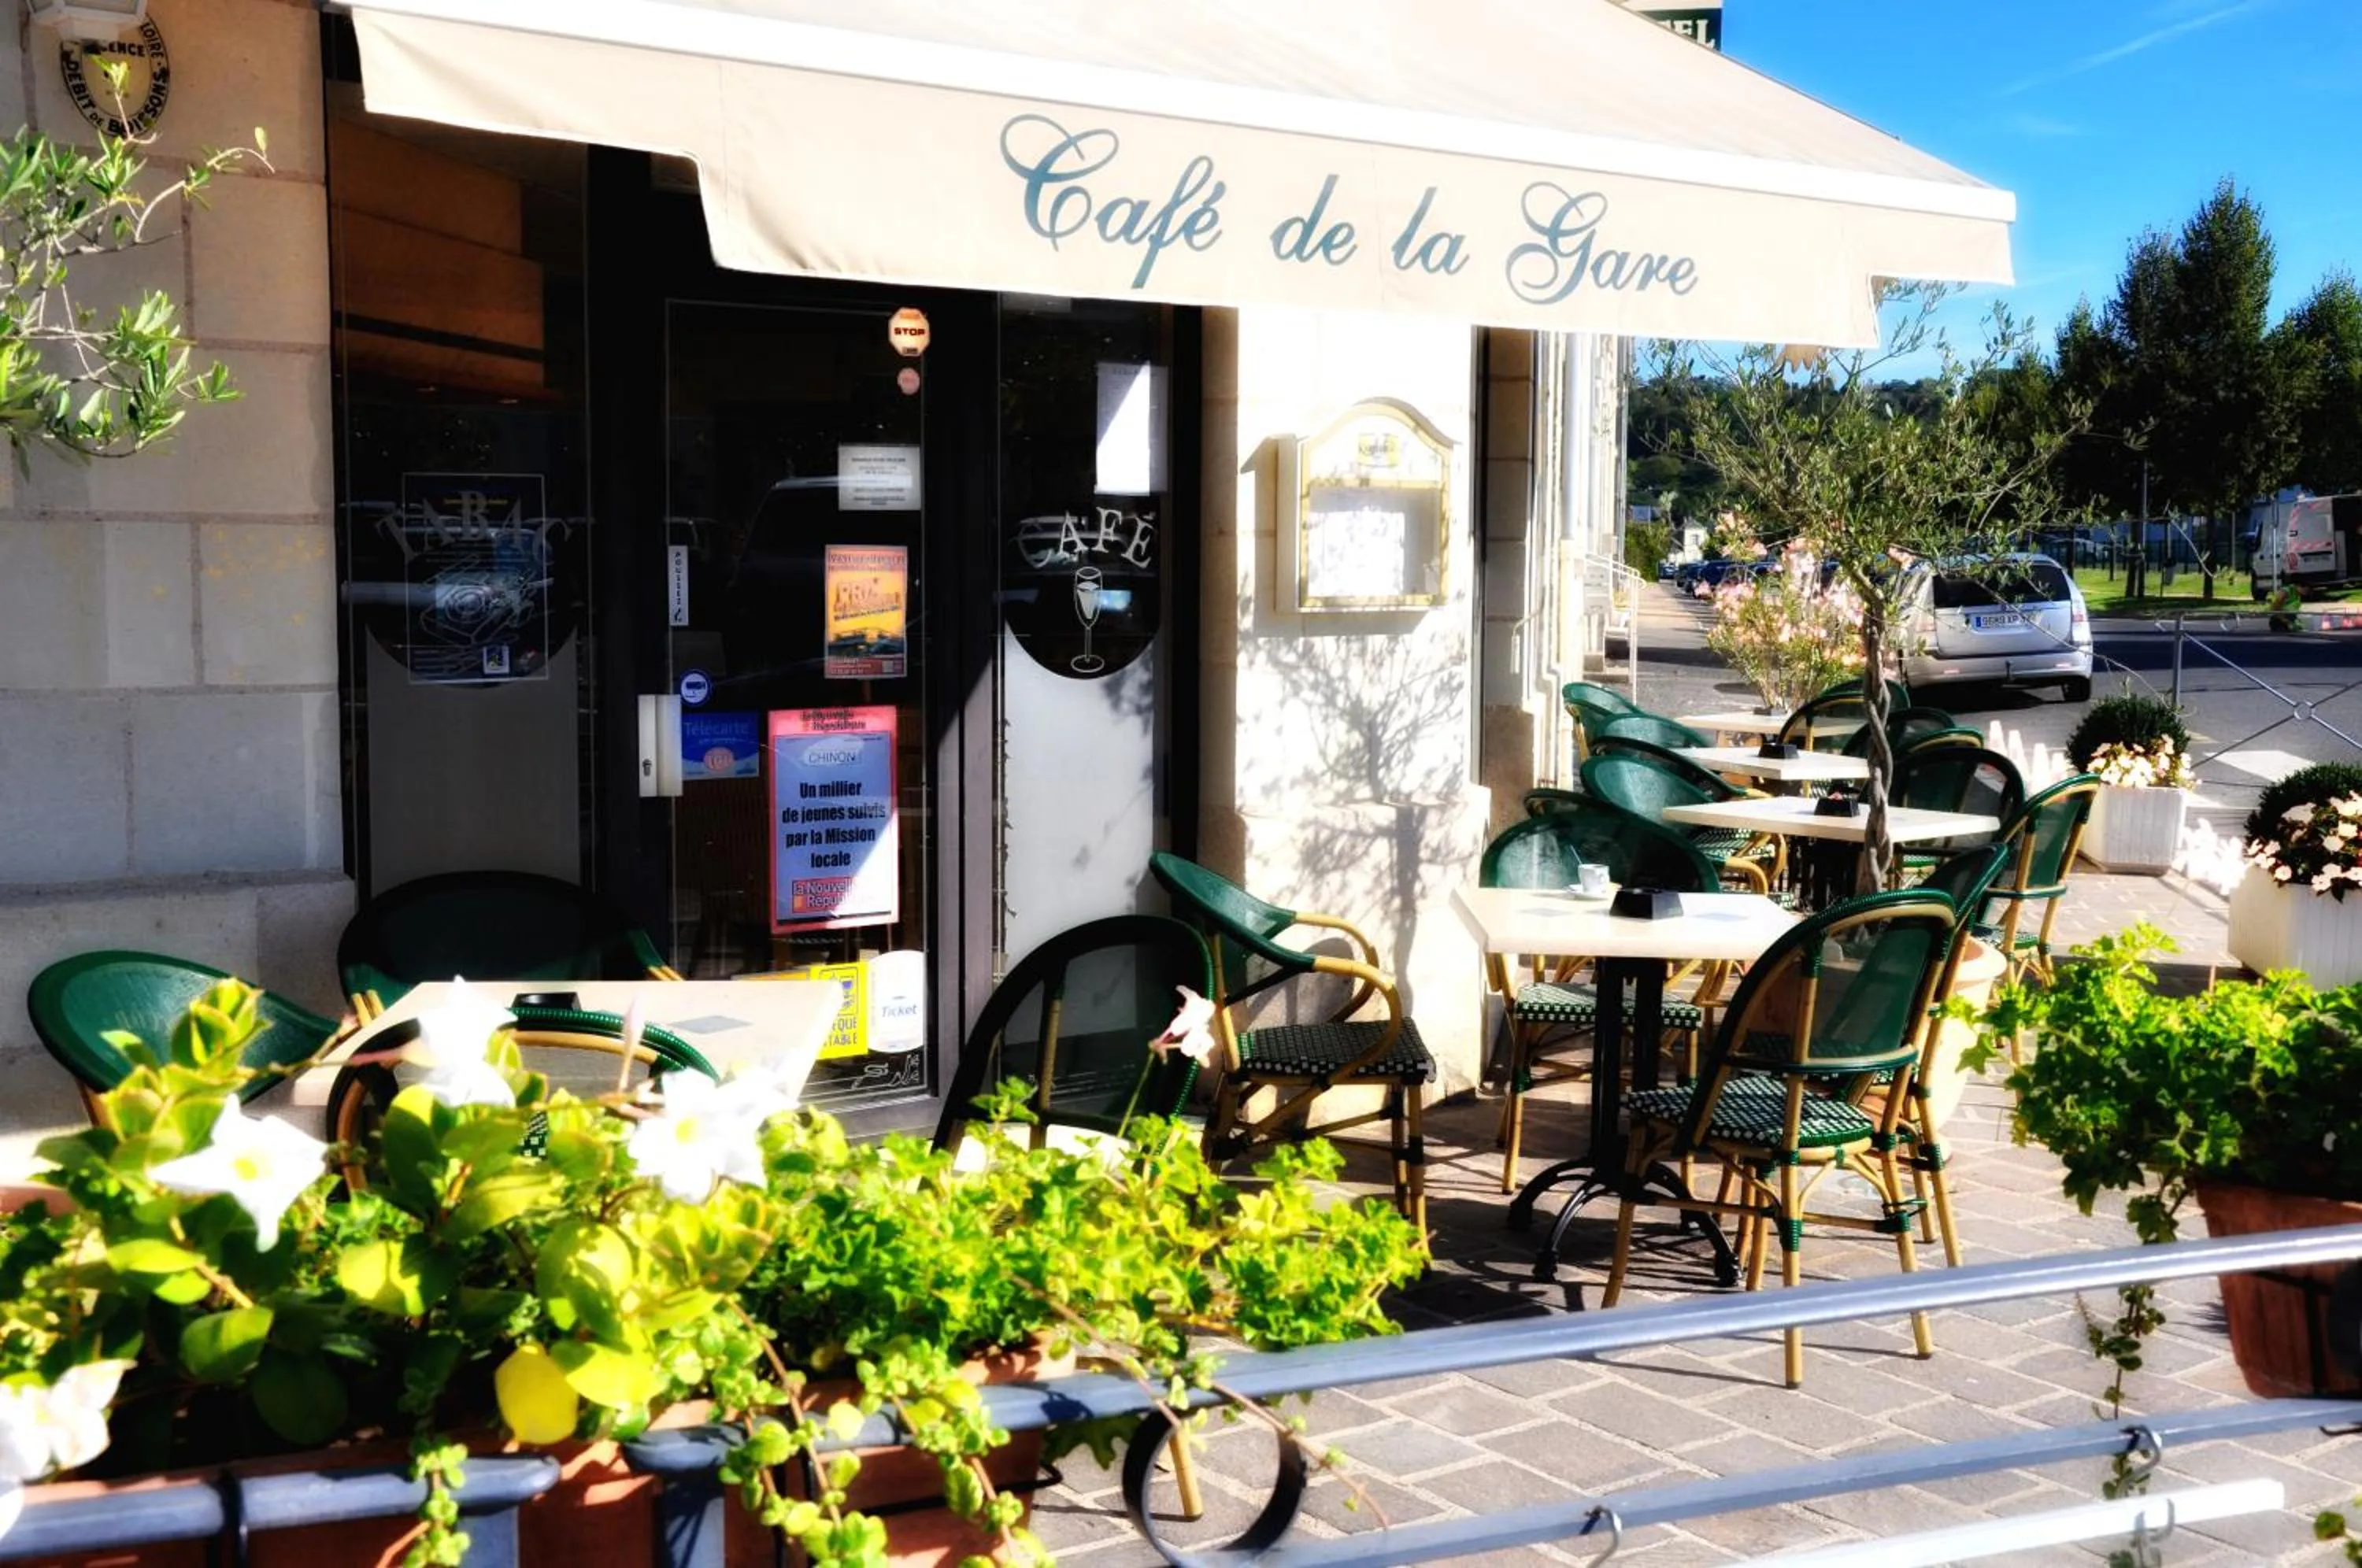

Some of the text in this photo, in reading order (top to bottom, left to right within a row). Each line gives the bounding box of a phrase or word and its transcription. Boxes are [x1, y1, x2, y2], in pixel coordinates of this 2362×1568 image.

[998, 113, 1700, 306] Café de la Gare
[894, 327, 926, 336] STOP
[809, 752, 857, 764] CHINON
[800, 781, 862, 798] Un millier
[782, 802, 887, 824] de jeunes suivis
[786, 828, 876, 849] par la Mission
[811, 851, 851, 868] locale
[881, 1004, 918, 1018] Ticket
